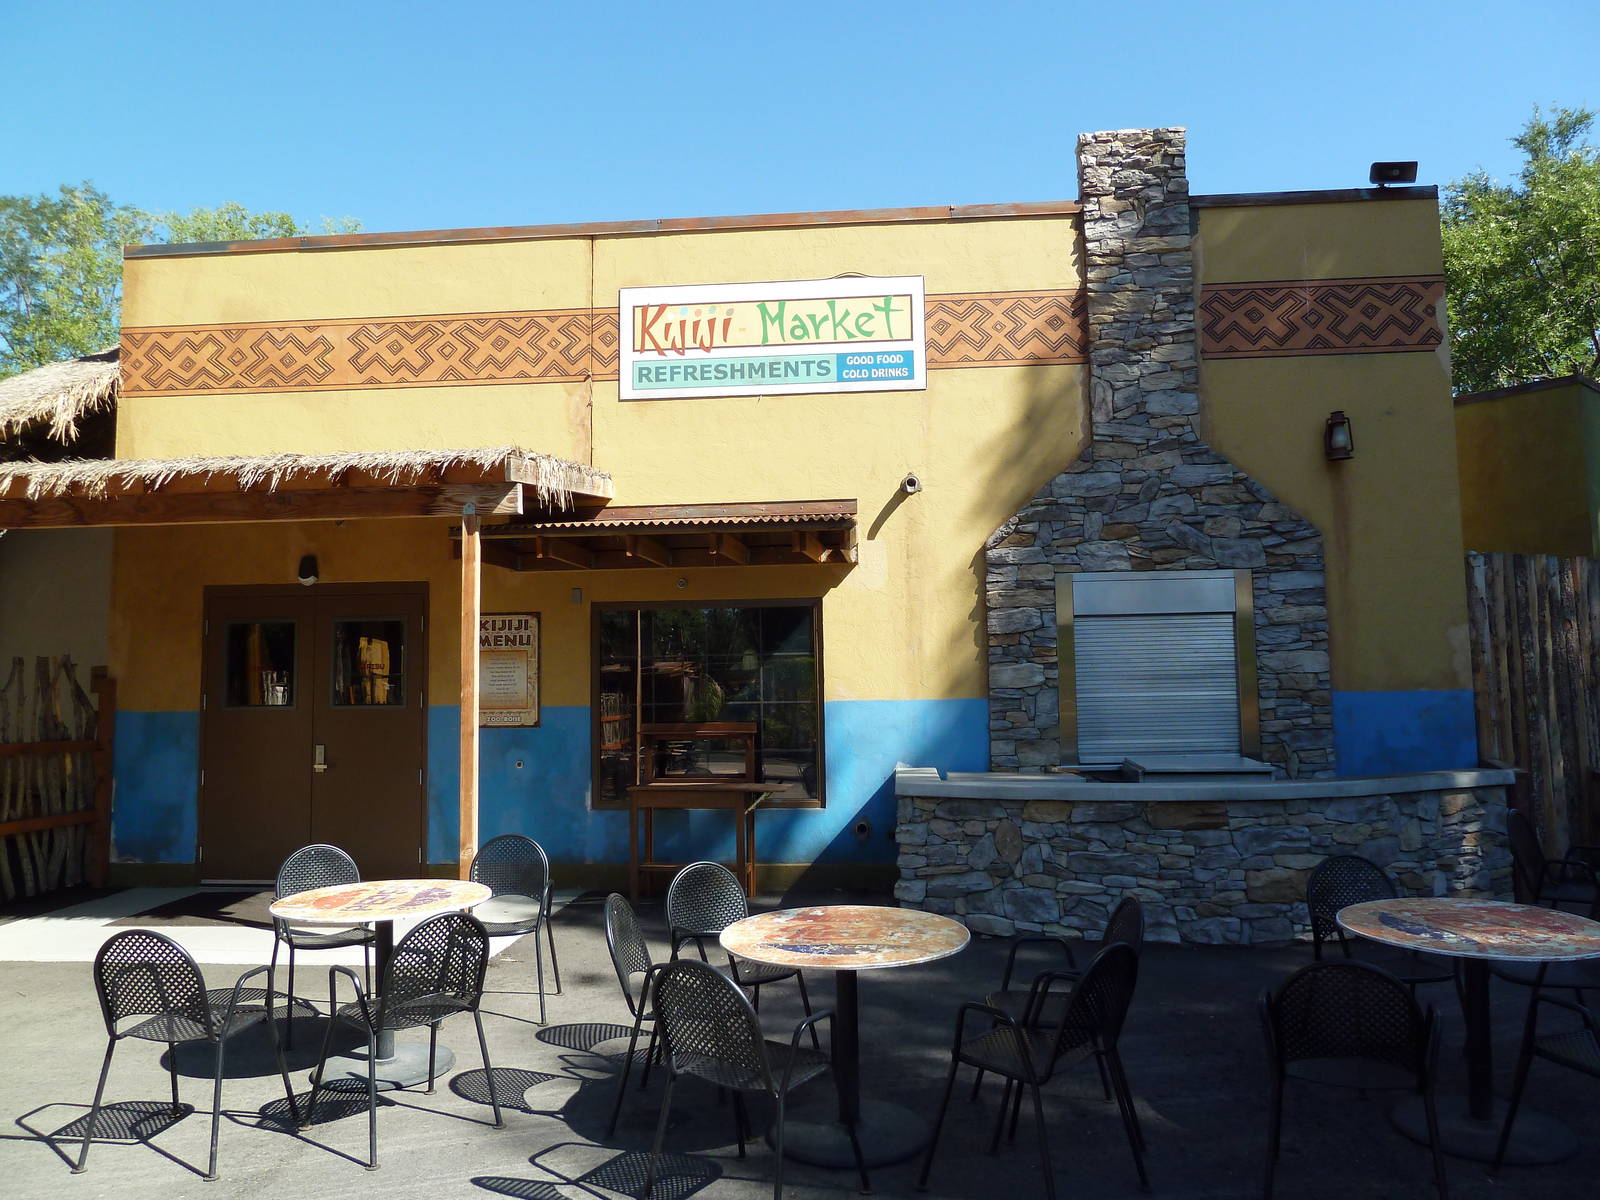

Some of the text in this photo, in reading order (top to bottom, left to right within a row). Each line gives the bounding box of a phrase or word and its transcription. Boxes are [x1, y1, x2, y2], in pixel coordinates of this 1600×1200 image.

[640, 296, 904, 356] Kijiji Market
[846, 354, 904, 365] GOOD FOOD
[638, 360, 832, 383] REFRESHMENTS
[842, 367, 909, 378] COLD DRINKS
[480, 619, 529, 631] KIJIJI
[480, 635, 531, 646] MENU
